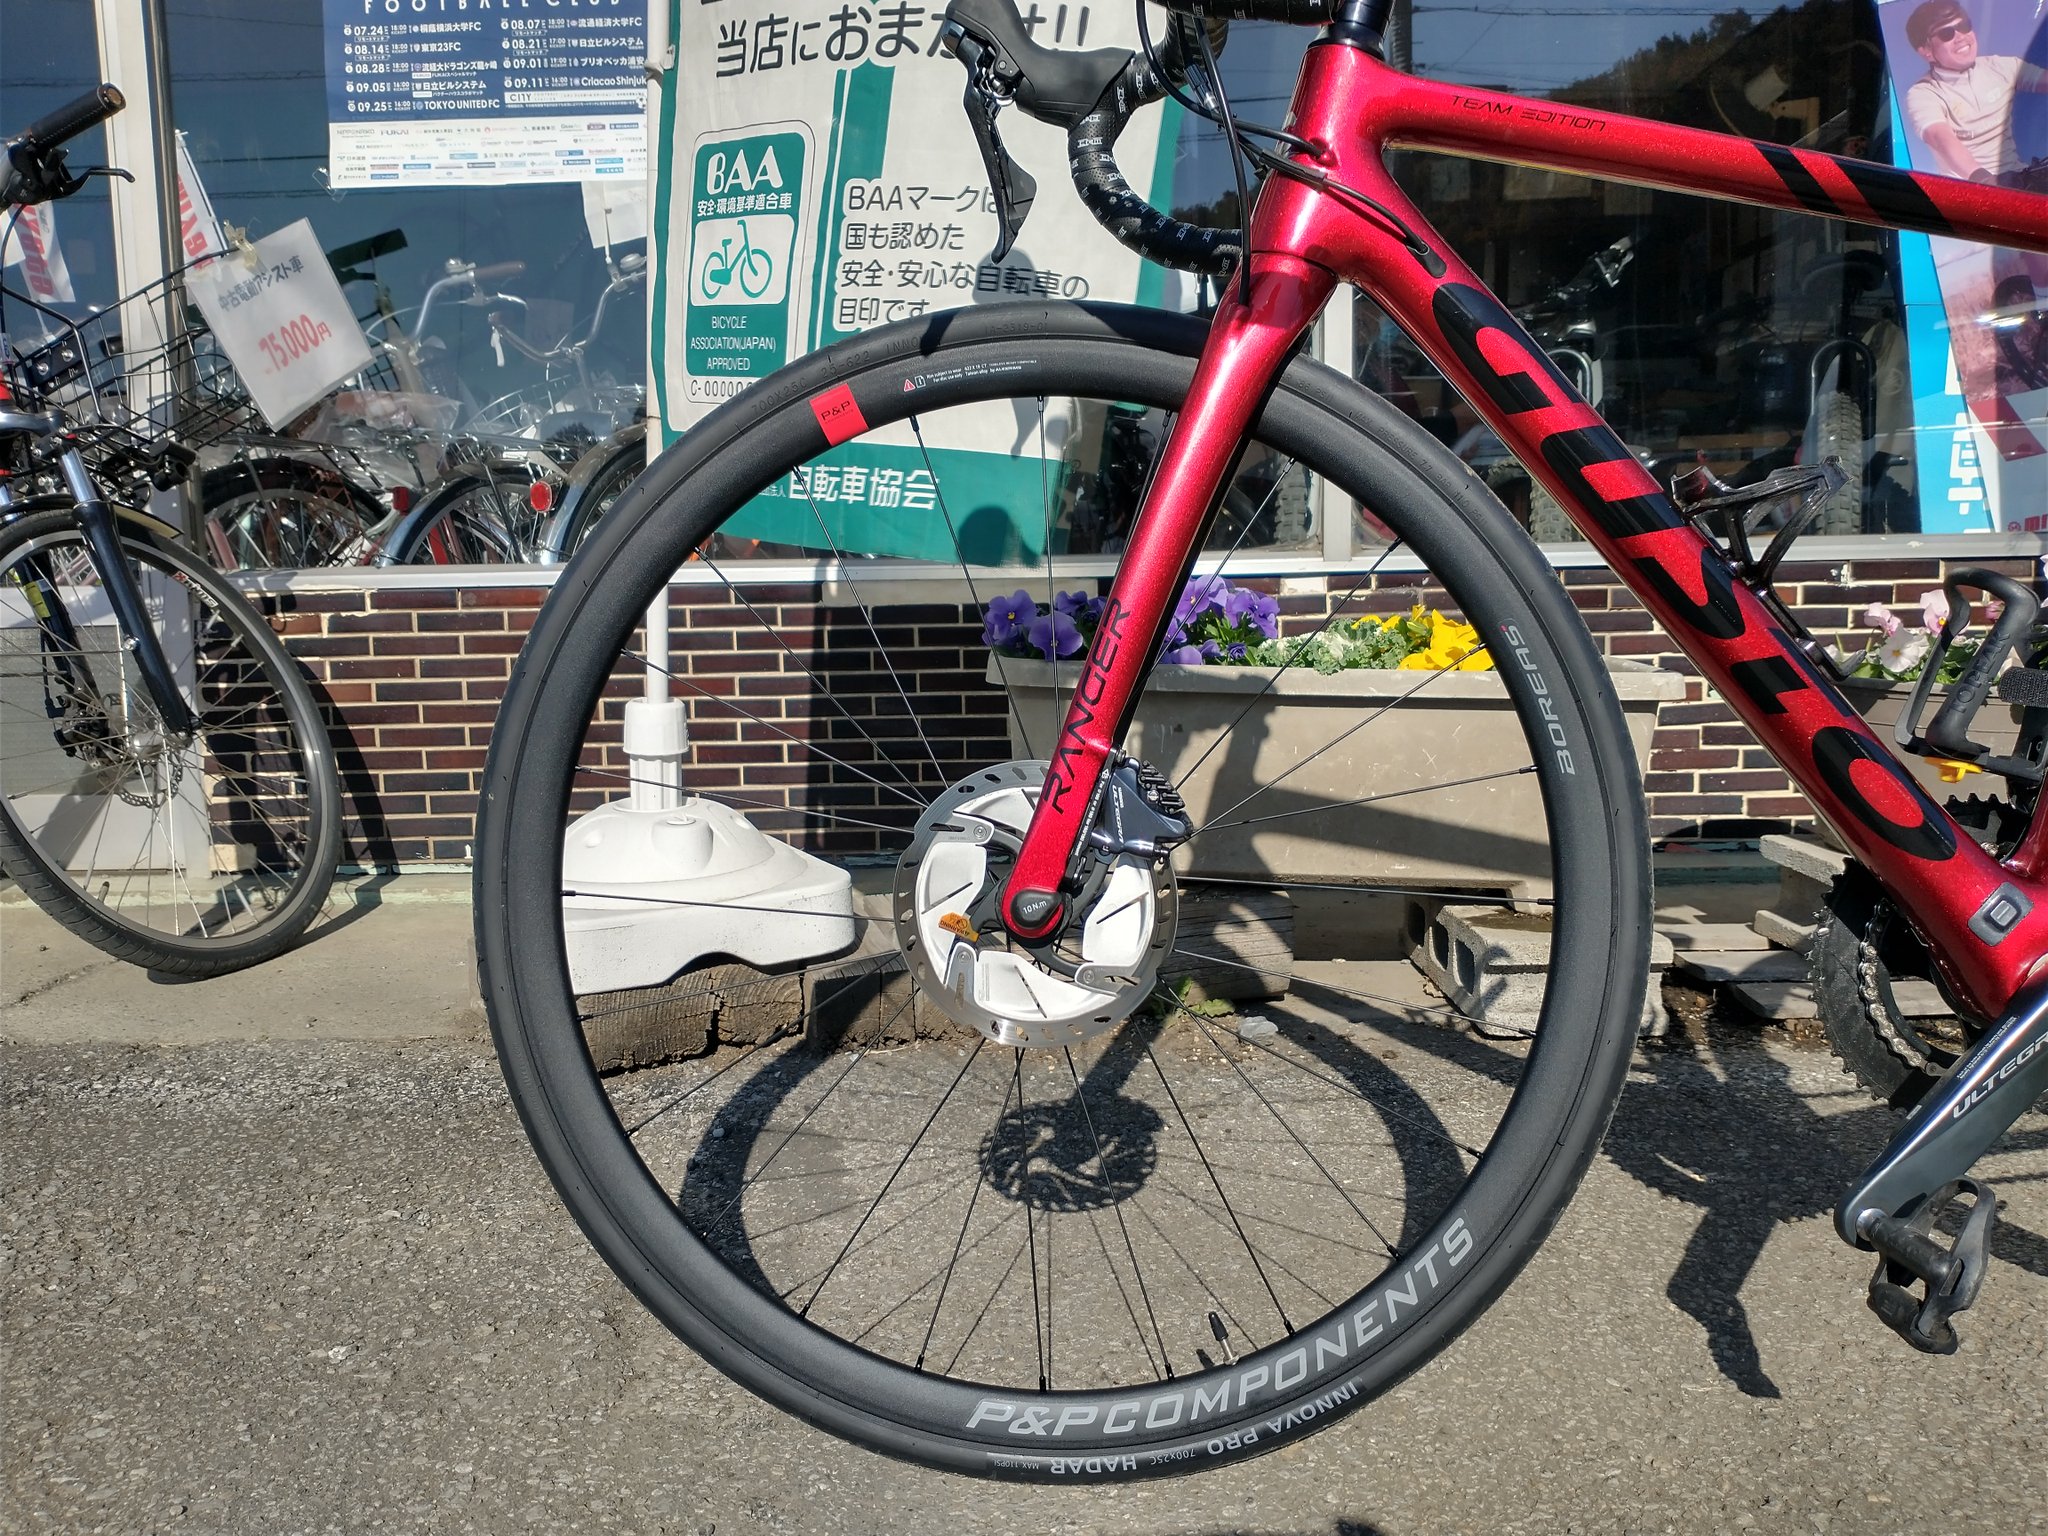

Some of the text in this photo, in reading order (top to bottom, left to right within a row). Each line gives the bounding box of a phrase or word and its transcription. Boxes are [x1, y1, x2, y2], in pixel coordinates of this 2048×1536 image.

[354, 25, 383, 36] 07.24
[511, 20, 540, 30] 08.07
[354, 45, 383, 55] 08.14
[512, 39, 540, 49] 08.21
[579, 37, 644, 48] 日立ビルシステム
[355, 63, 385, 74] 08.28
[513, 59, 541, 69] 09.01
[356, 82, 385, 93] 09.05
[423, 80, 487, 90] 日立ビルシステム
[514, 78, 542, 88] 09.11
[581, 77, 616, 86] Criacao
[358, 101, 387, 112] 09.25
[425, 101, 457, 110] TOKYO
[457, 100, 488, 109] UNITED
[488, 99, 500, 108] FC
[1452, 95, 1607, 132] TEAM EDITION
[707, 145, 784, 195] BAA
[845, 221, 965, 251] 国も認めた
[217, 254, 305, 312] 中古電動アシスト車
[841, 260, 1090, 301] 安全・安心な自転車の
[711, 315, 747, 329] BICYCLE
[706, 357, 751, 371] APPROVED
[690, 380, 753, 397] C-00000
[821, 400, 851, 421] P&P
[789, 464, 940, 510] 自転車協会
[1432, 281, 1958, 861] GUSTO
[1042, 597, 1132, 815] RANGER
[1503, 624, 1576, 776] BOREAS
[1268, 1378, 1361, 1436] INNOVA
[1208, 1430, 1260, 1457] PRO
[1021, 1461, 1040, 1470] MAX
[1050, 1454, 1138, 1475] HADAR
[1150, 1448, 1197, 1467] 700x25C
